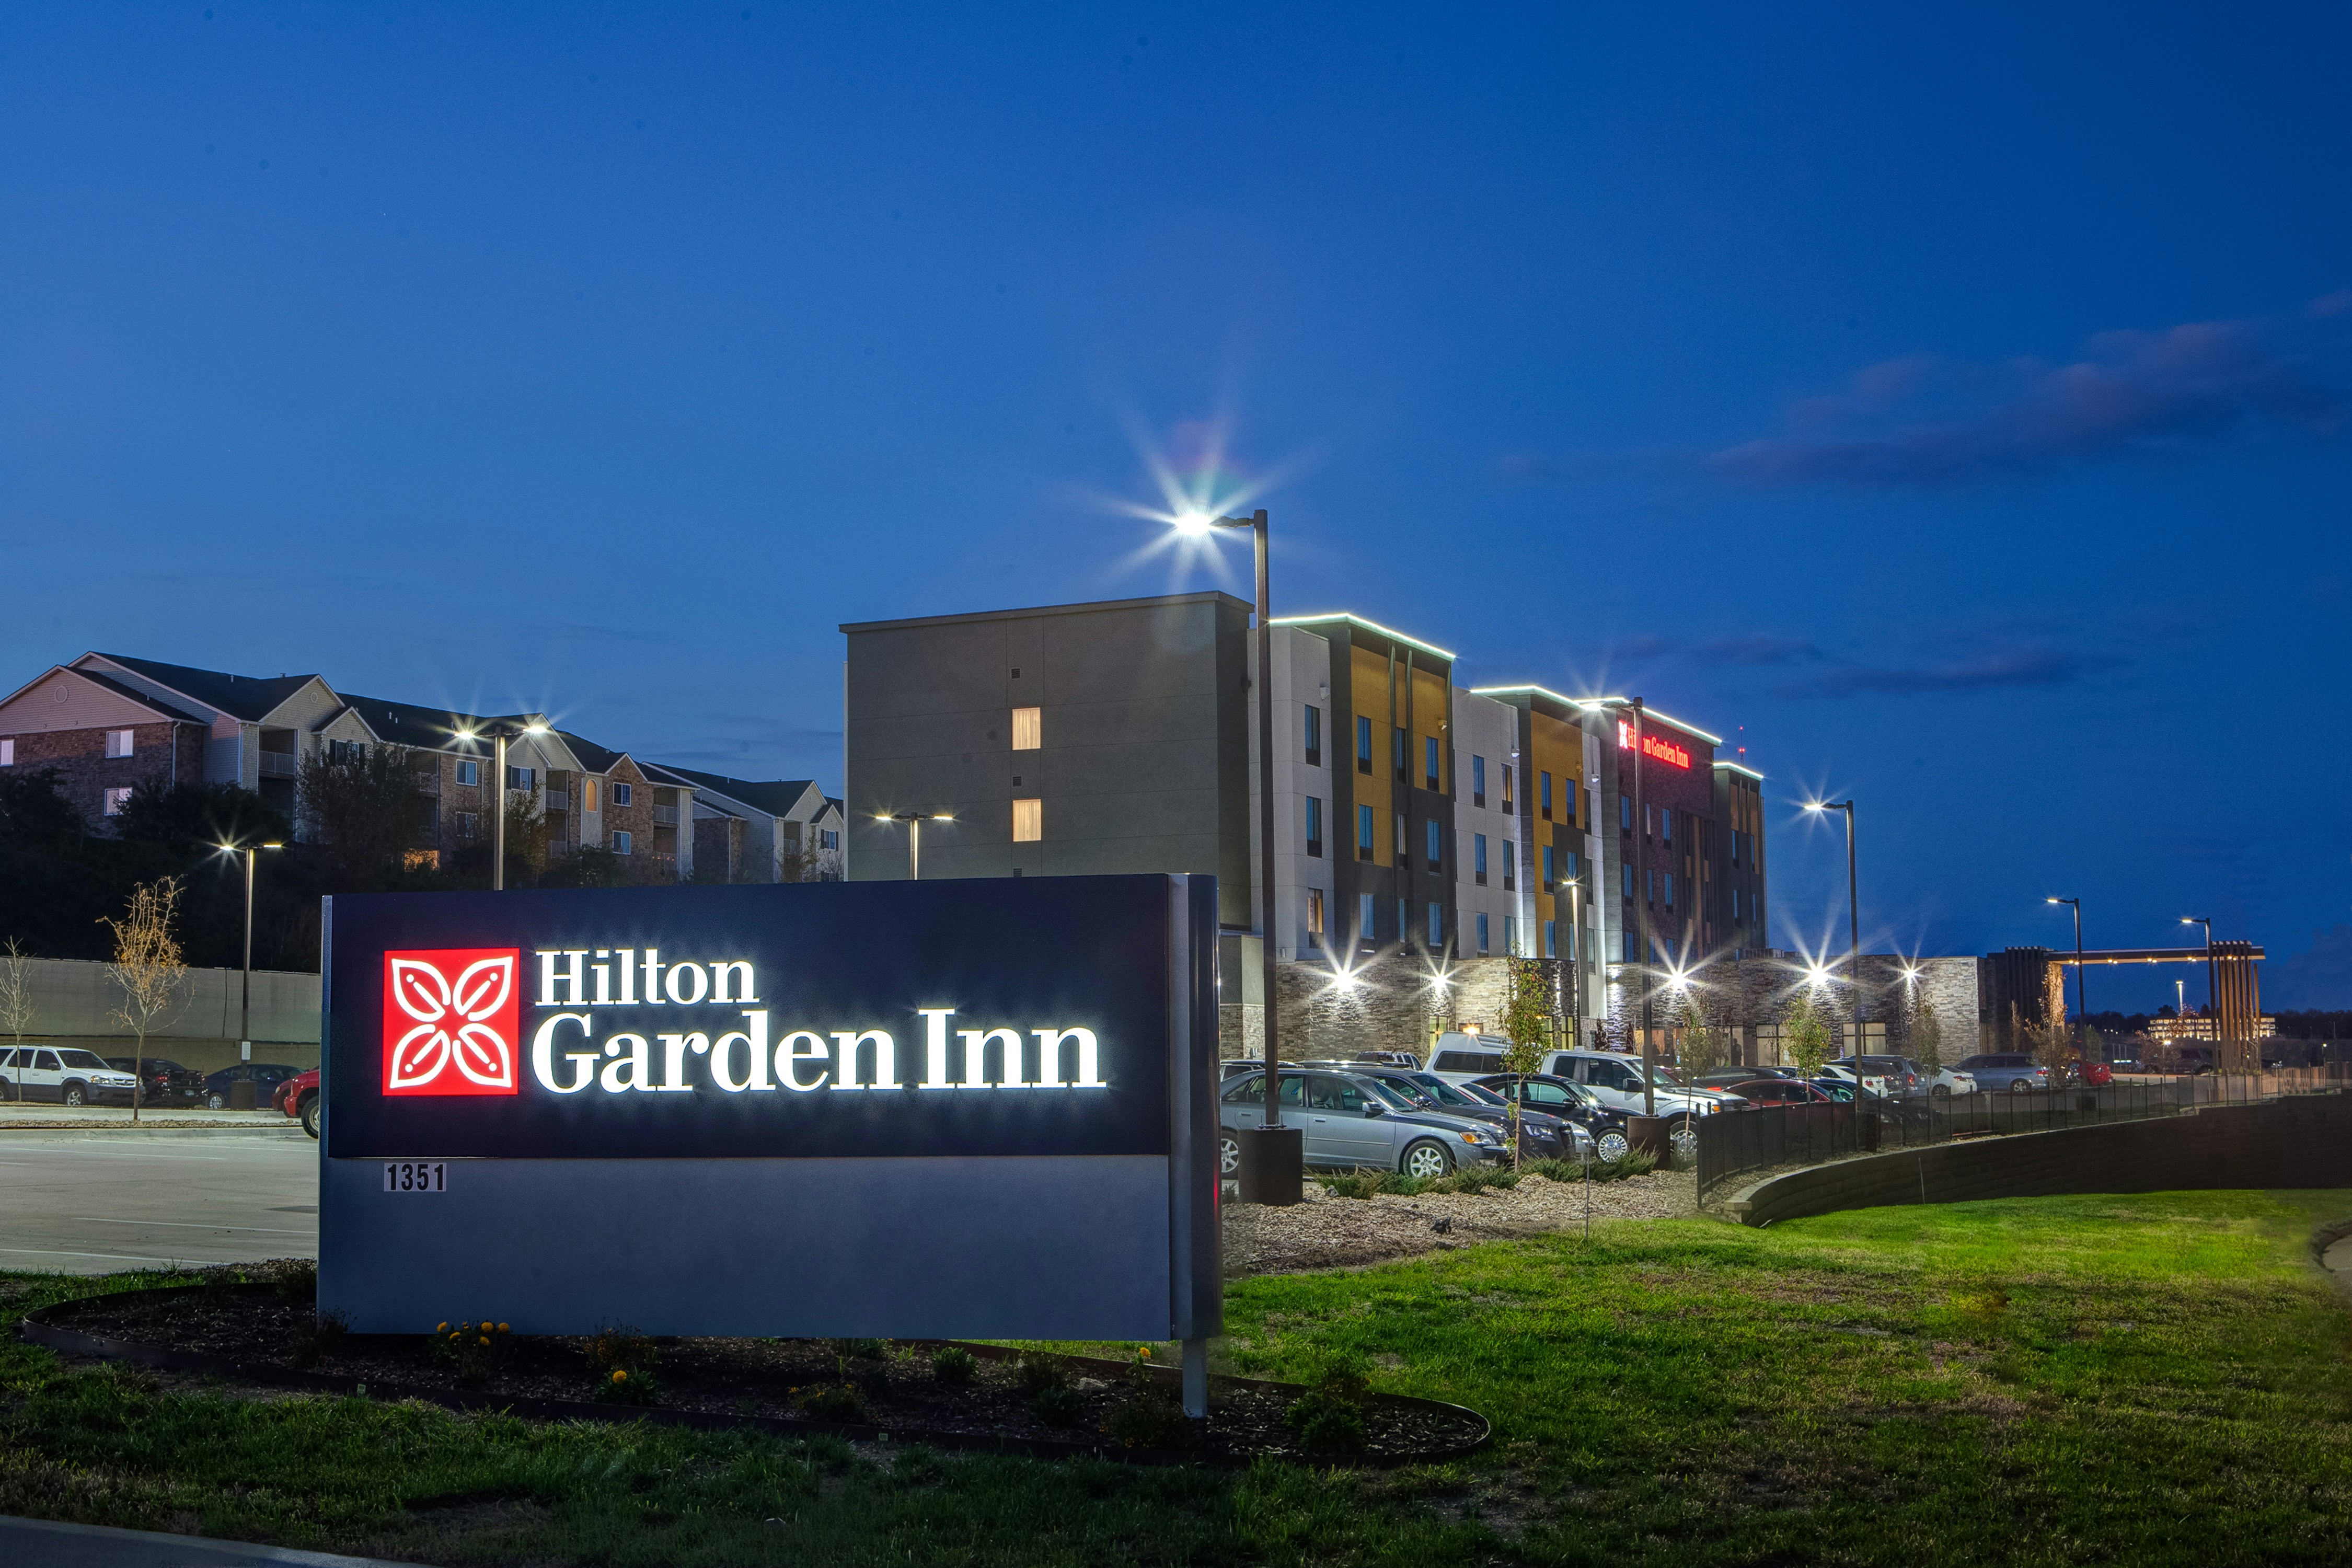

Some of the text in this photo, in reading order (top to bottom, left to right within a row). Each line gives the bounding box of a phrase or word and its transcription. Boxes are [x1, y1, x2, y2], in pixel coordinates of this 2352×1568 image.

[1652, 736, 1675, 764] Garden
[1676, 745, 1689, 768] Inn
[535, 949, 760, 1006] Hilton
[532, 1008, 1106, 1093] Garden Inn
[387, 1164, 444, 1191] 1351
